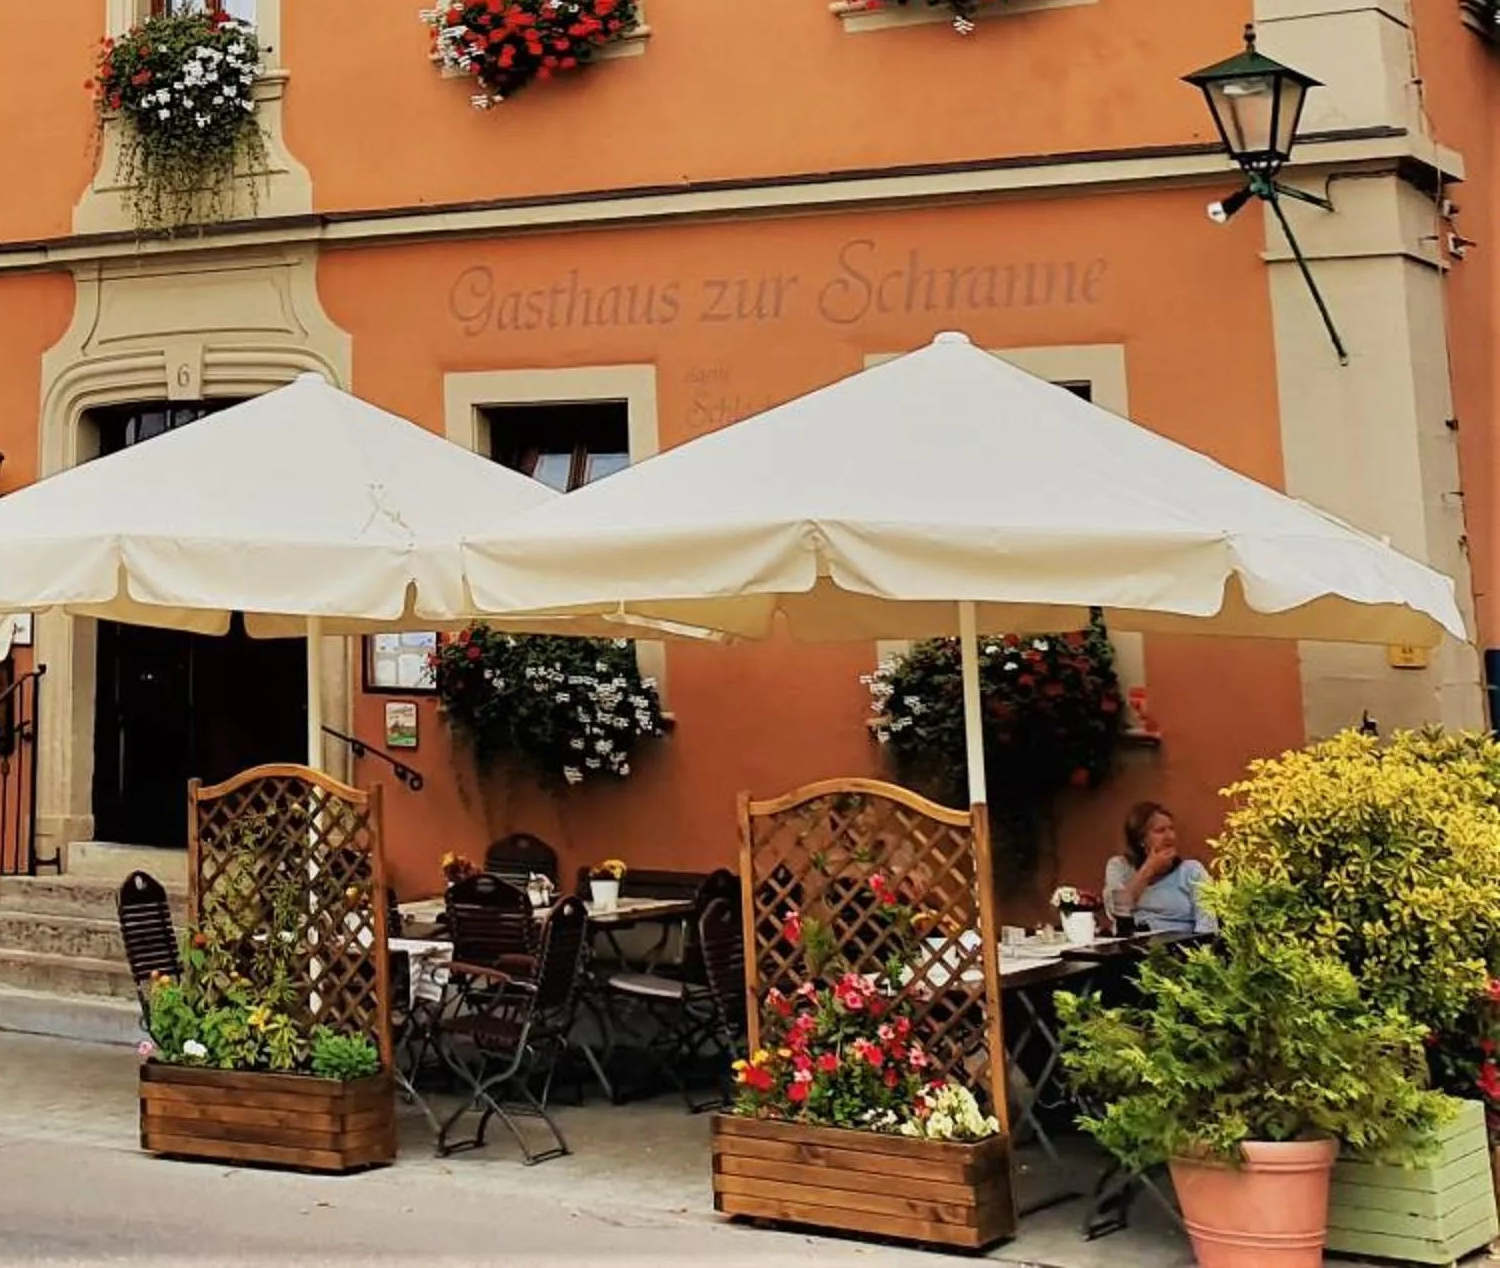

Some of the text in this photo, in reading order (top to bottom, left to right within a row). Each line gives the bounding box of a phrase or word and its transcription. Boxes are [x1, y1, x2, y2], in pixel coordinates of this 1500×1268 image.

[448, 238, 1109, 338] Gasthaus zur Schranne
